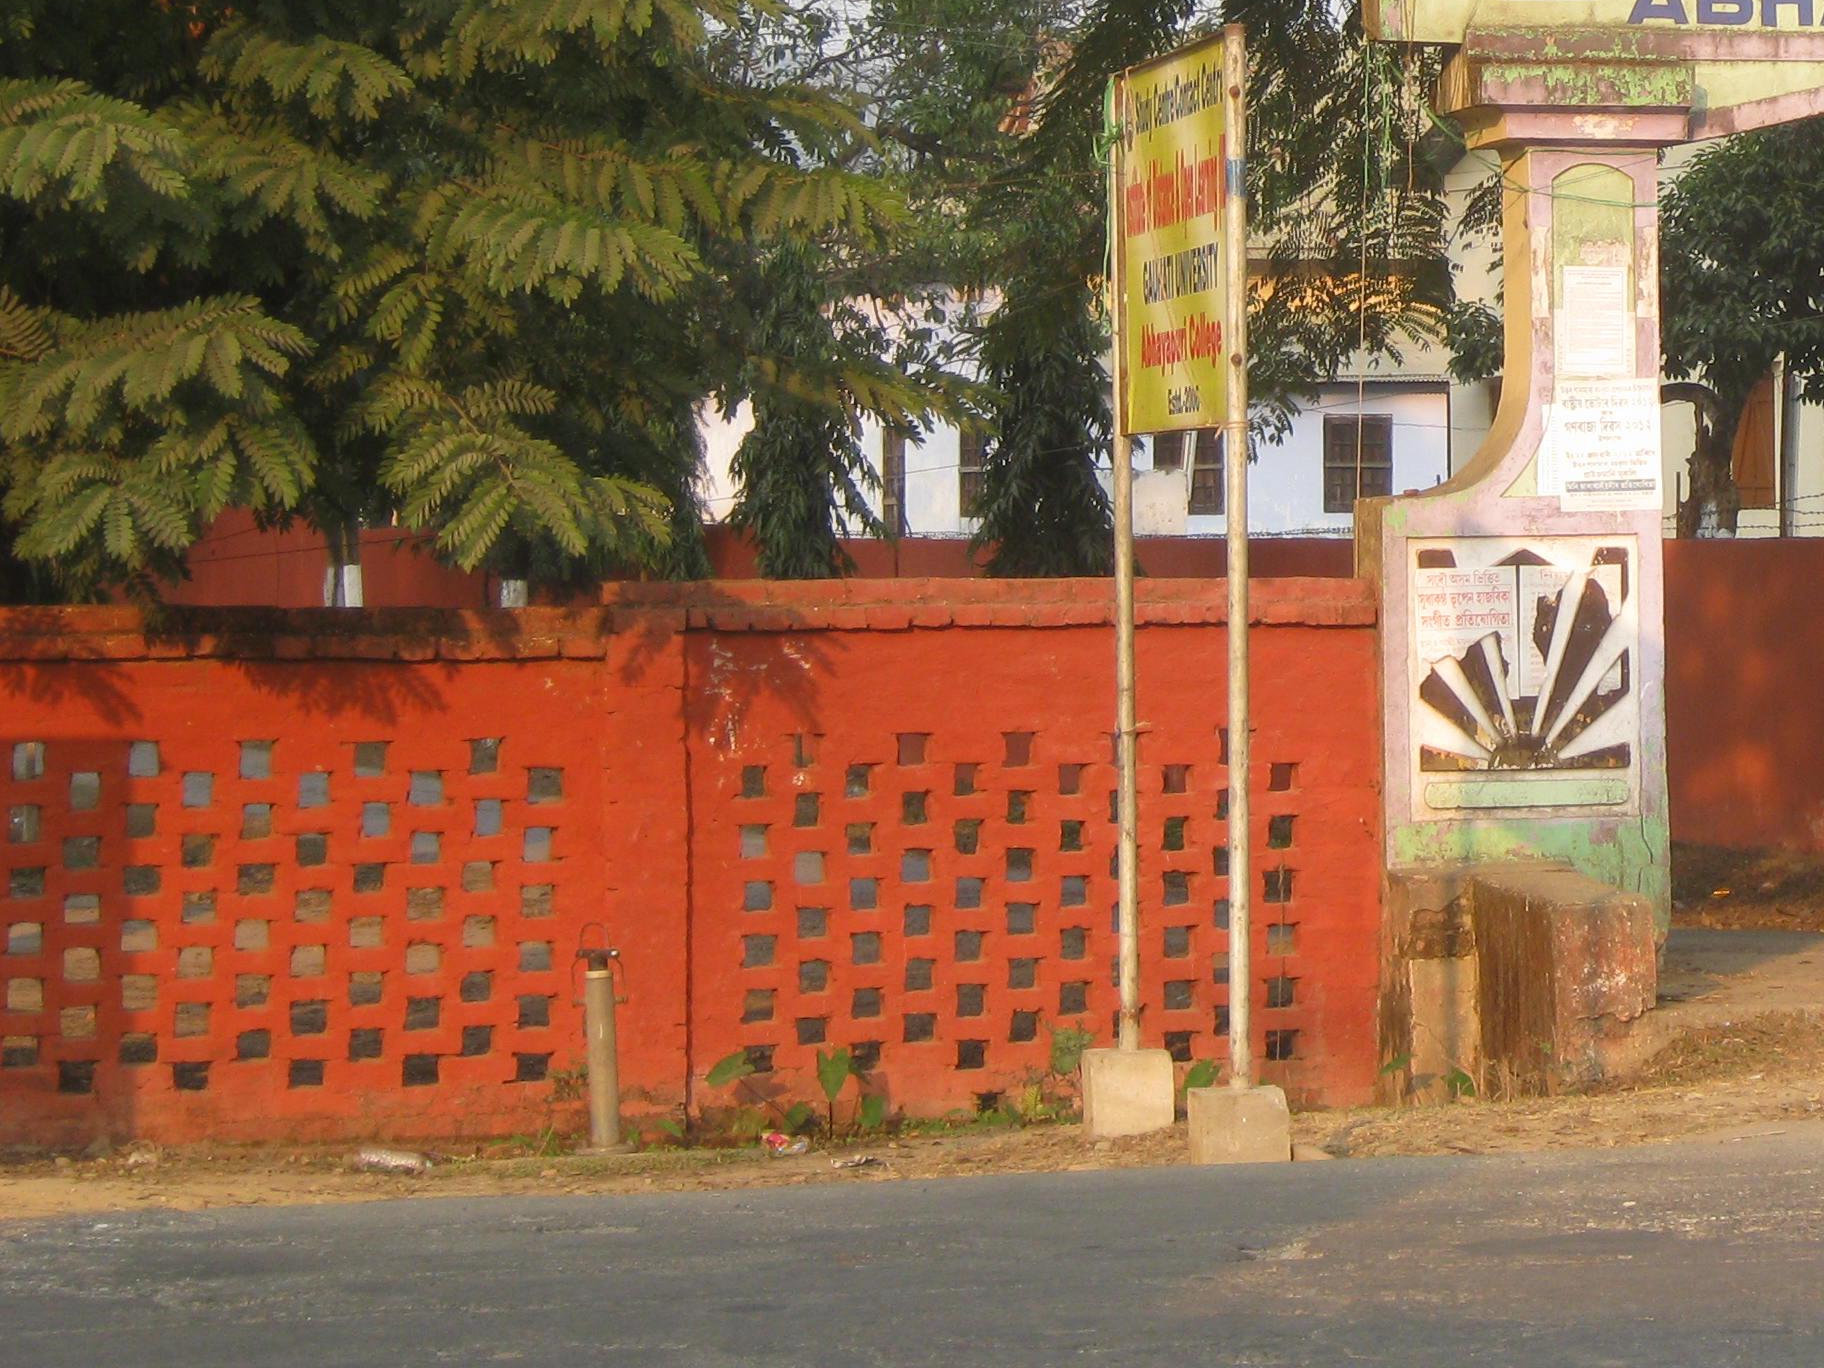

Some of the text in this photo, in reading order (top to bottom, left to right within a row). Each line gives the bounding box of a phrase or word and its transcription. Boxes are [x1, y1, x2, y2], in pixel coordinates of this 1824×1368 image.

[1143, 242, 1219, 306] GAUHATI UNIVERSITY
[1141, 312, 1222, 377] Abhayapuri College
